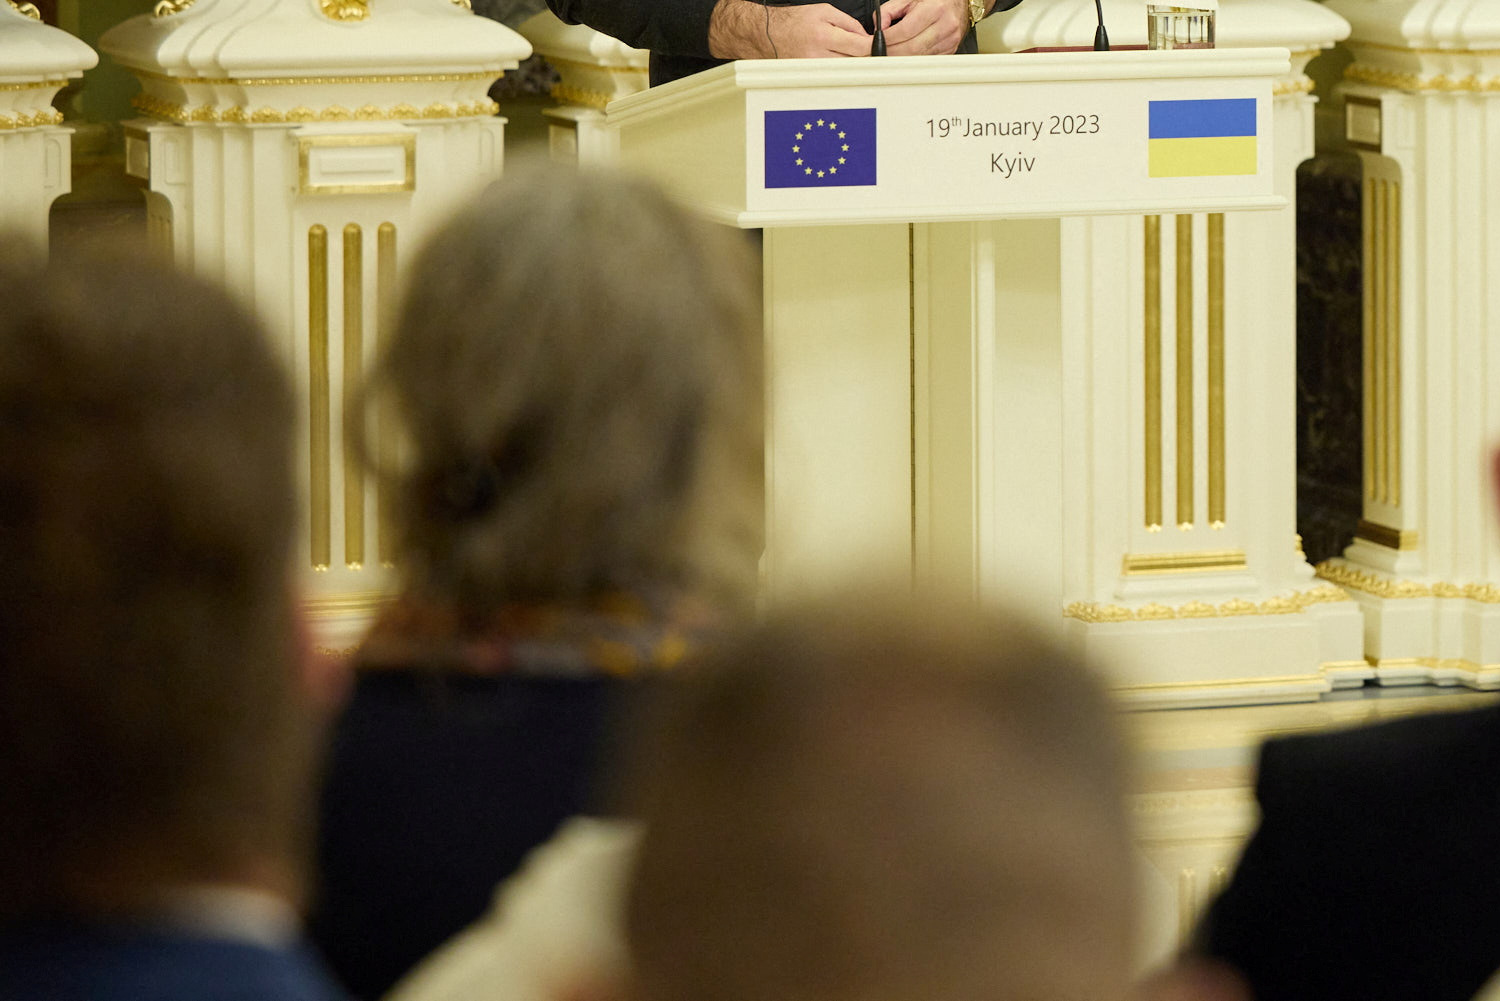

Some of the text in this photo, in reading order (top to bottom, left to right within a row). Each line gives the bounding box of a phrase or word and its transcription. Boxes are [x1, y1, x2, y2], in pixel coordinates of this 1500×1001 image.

[962, 118, 1044, 141] January
[1049, 114, 1100, 135] 2023
[991, 151, 1036, 179] Kyiv
